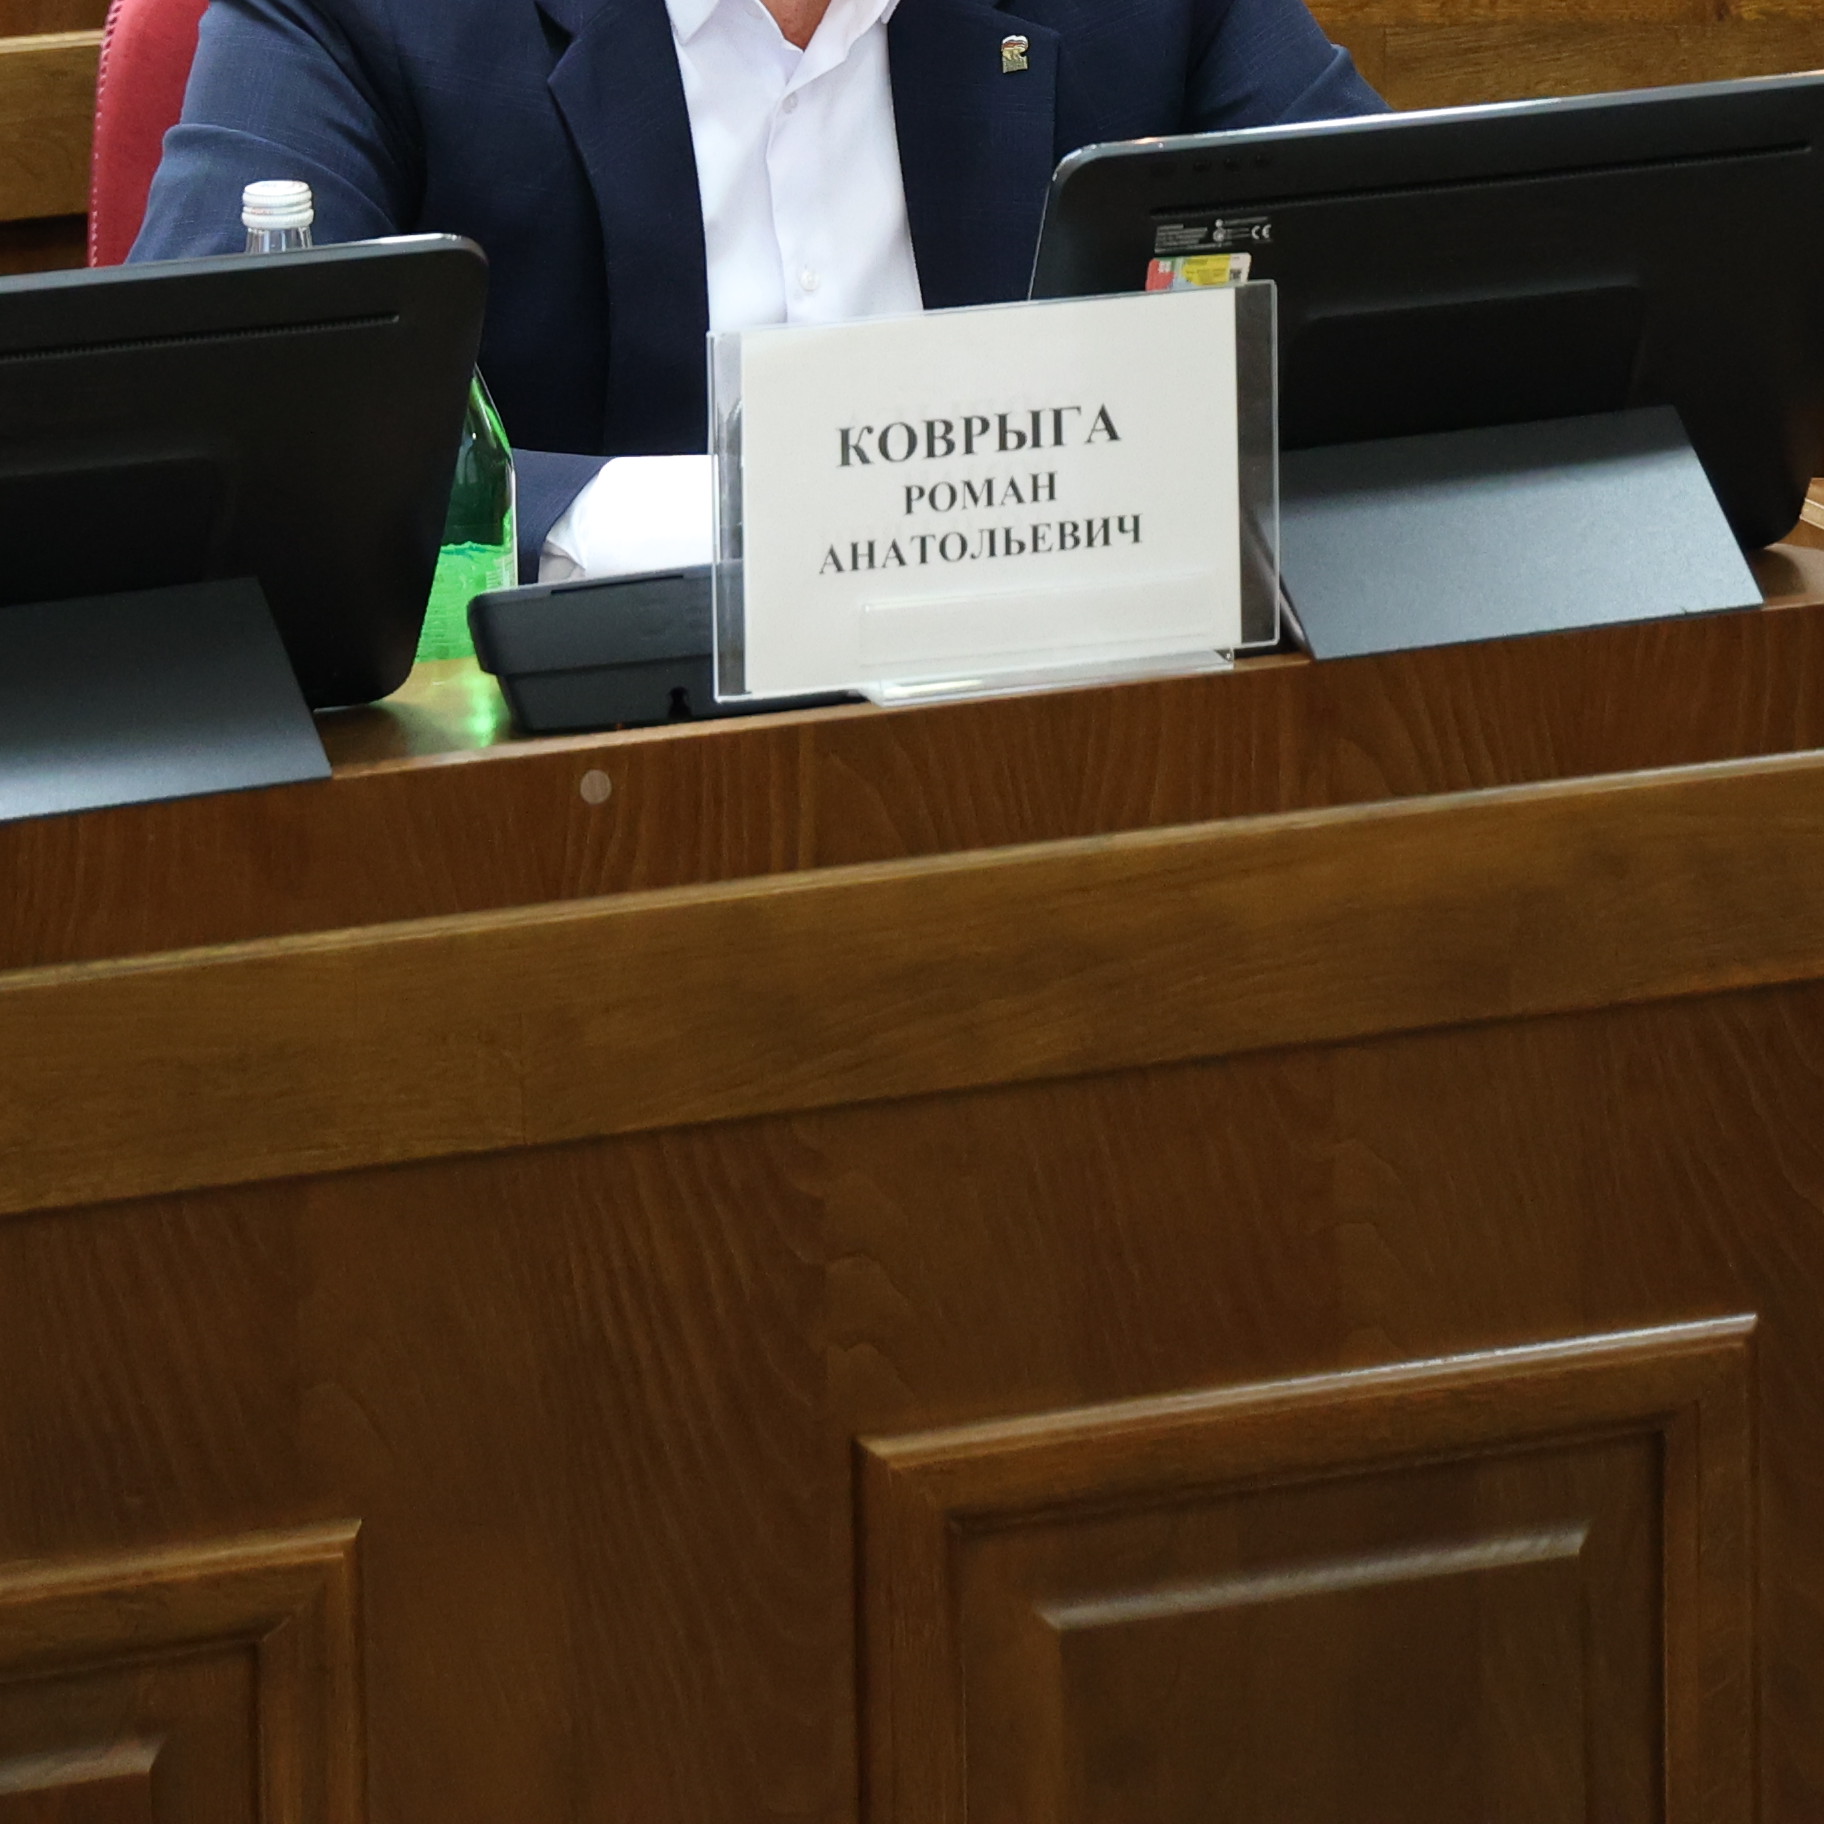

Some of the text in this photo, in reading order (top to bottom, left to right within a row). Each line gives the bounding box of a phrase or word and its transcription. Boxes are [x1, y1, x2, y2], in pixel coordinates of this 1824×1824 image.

[837, 404, 1122, 468] КОВРЫГА
[903, 470, 1058, 515] РОМАН
[819, 513, 1143, 575] АНАТОЛЬЕВИЧ
